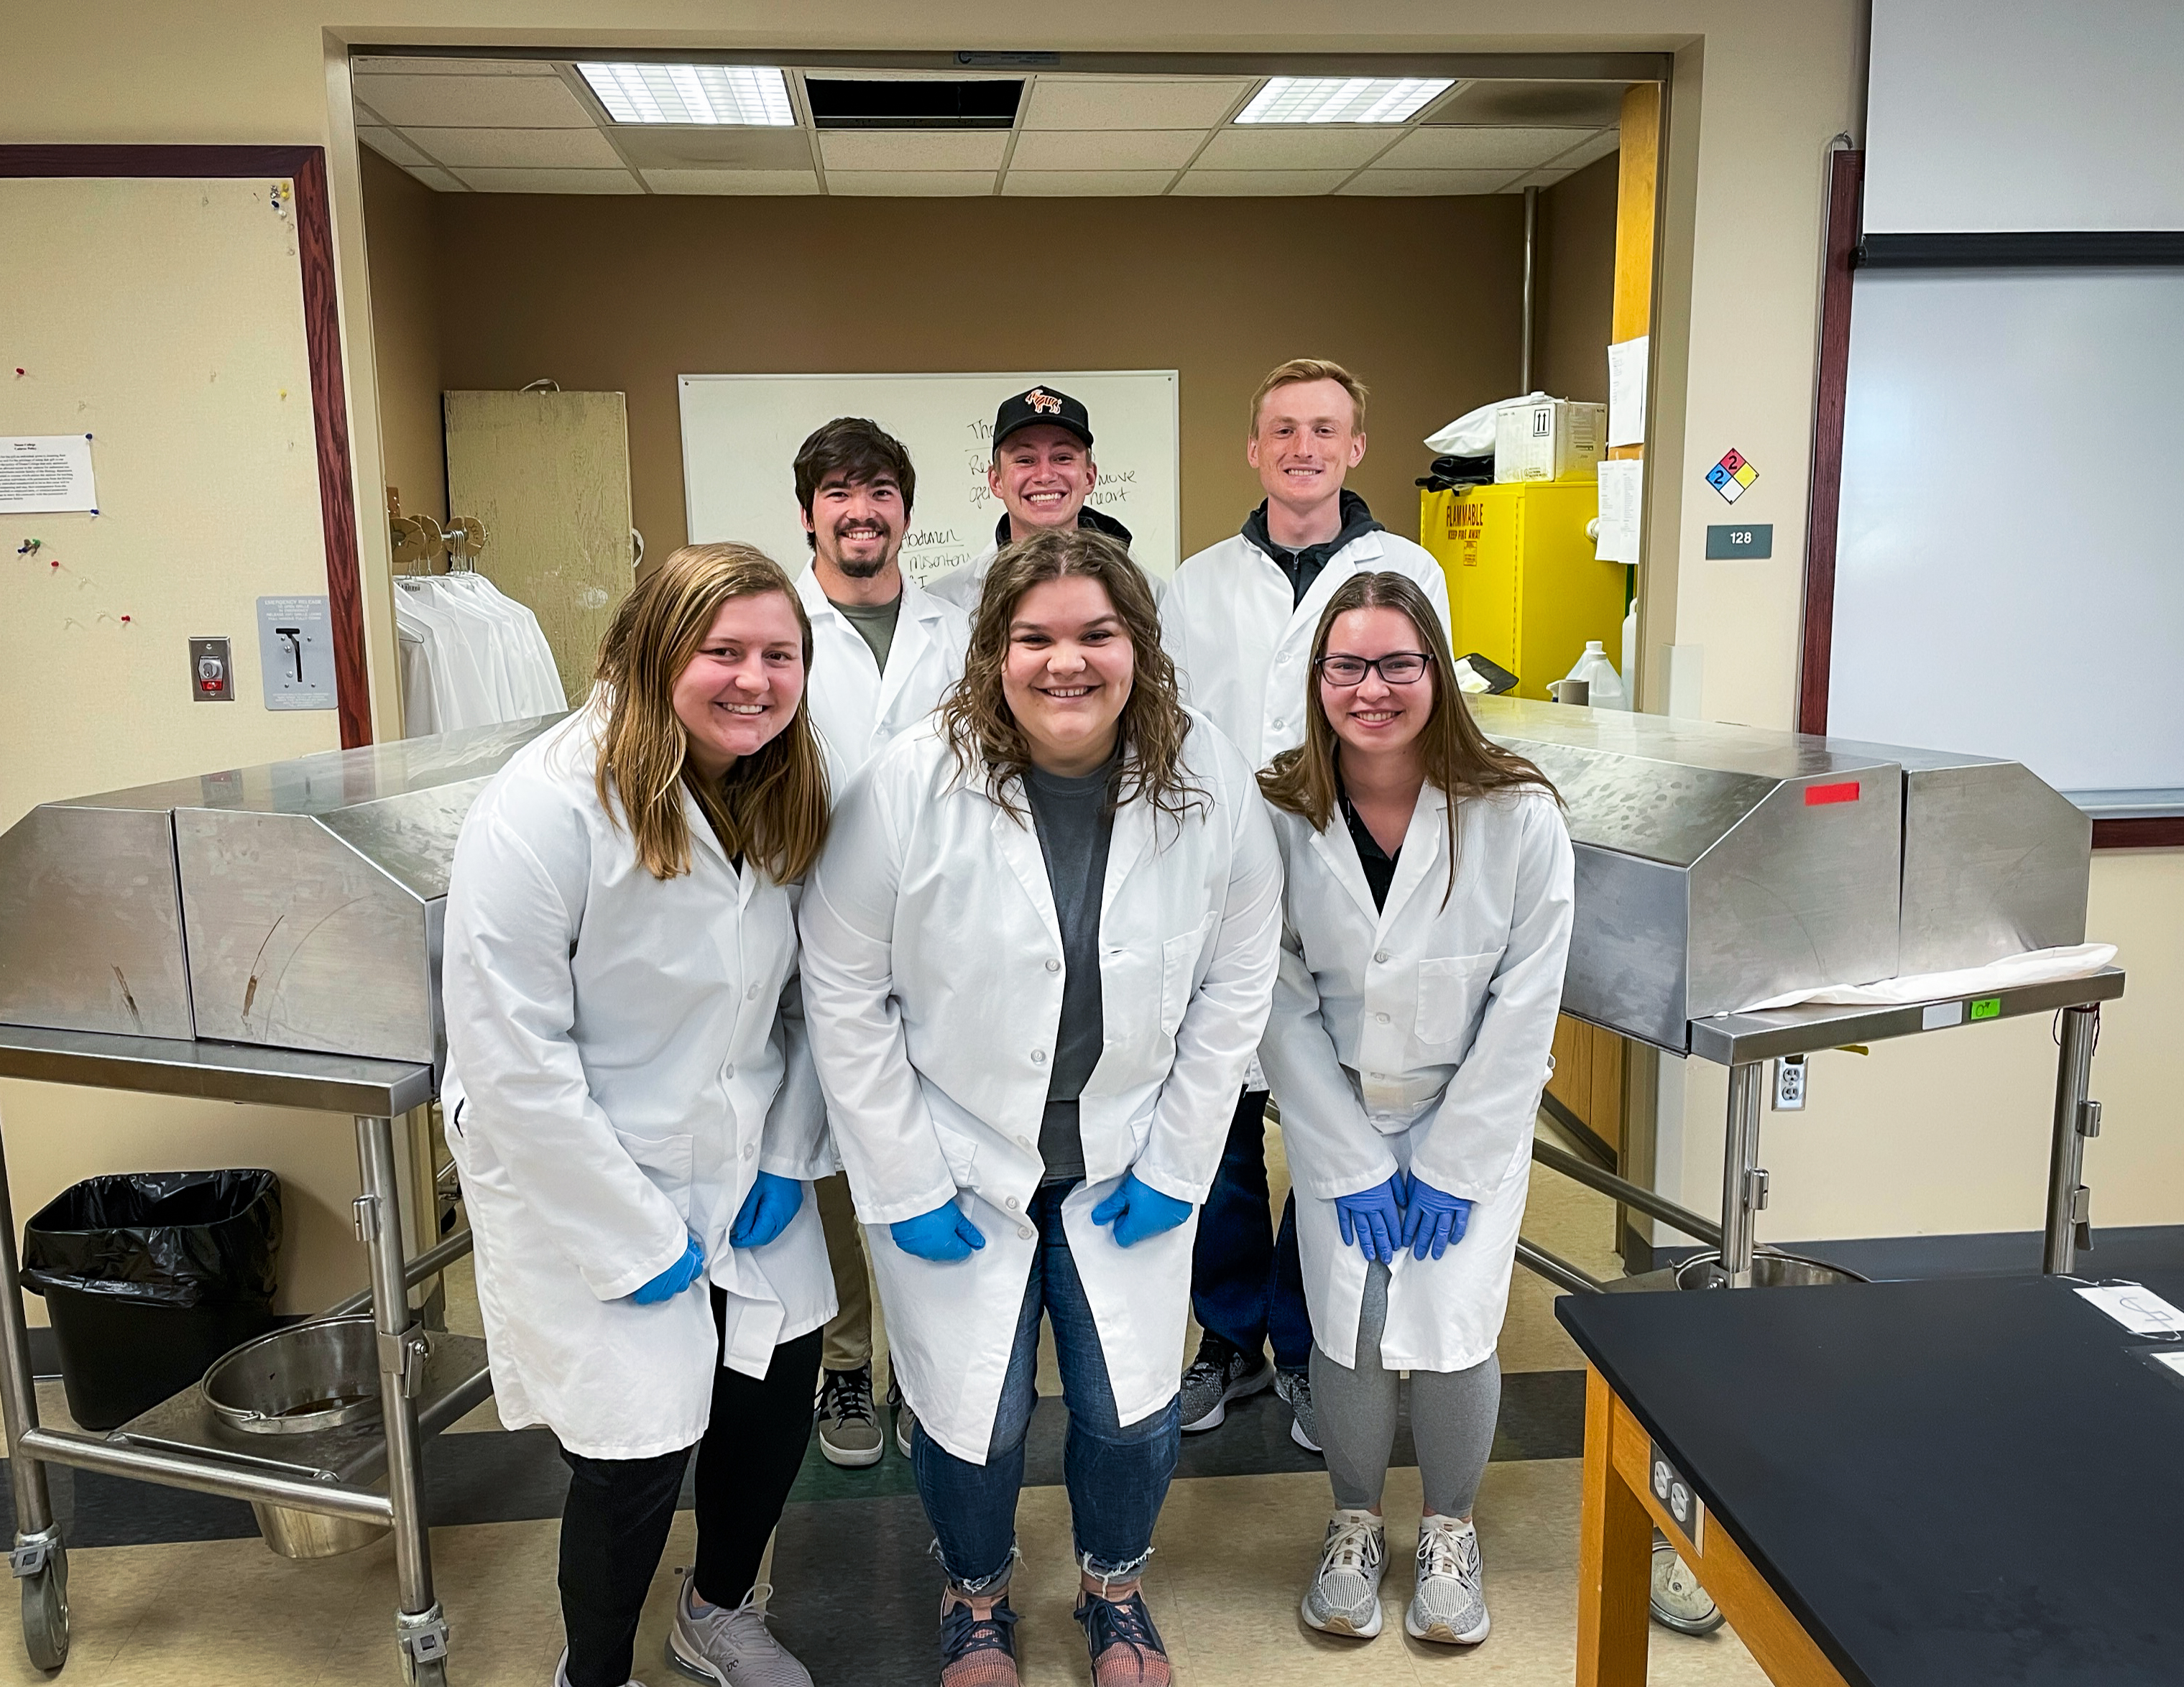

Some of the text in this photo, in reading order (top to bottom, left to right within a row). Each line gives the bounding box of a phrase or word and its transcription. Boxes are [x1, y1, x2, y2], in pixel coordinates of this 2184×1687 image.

[1728, 455, 1738, 471] 2
[1713, 469, 1725, 485] 2
[1446, 504, 1483, 527] FLAMMABLE
[1447, 529, 1481, 540] KEEP FIRE AWAY
[1730, 532, 1752, 544] 128
